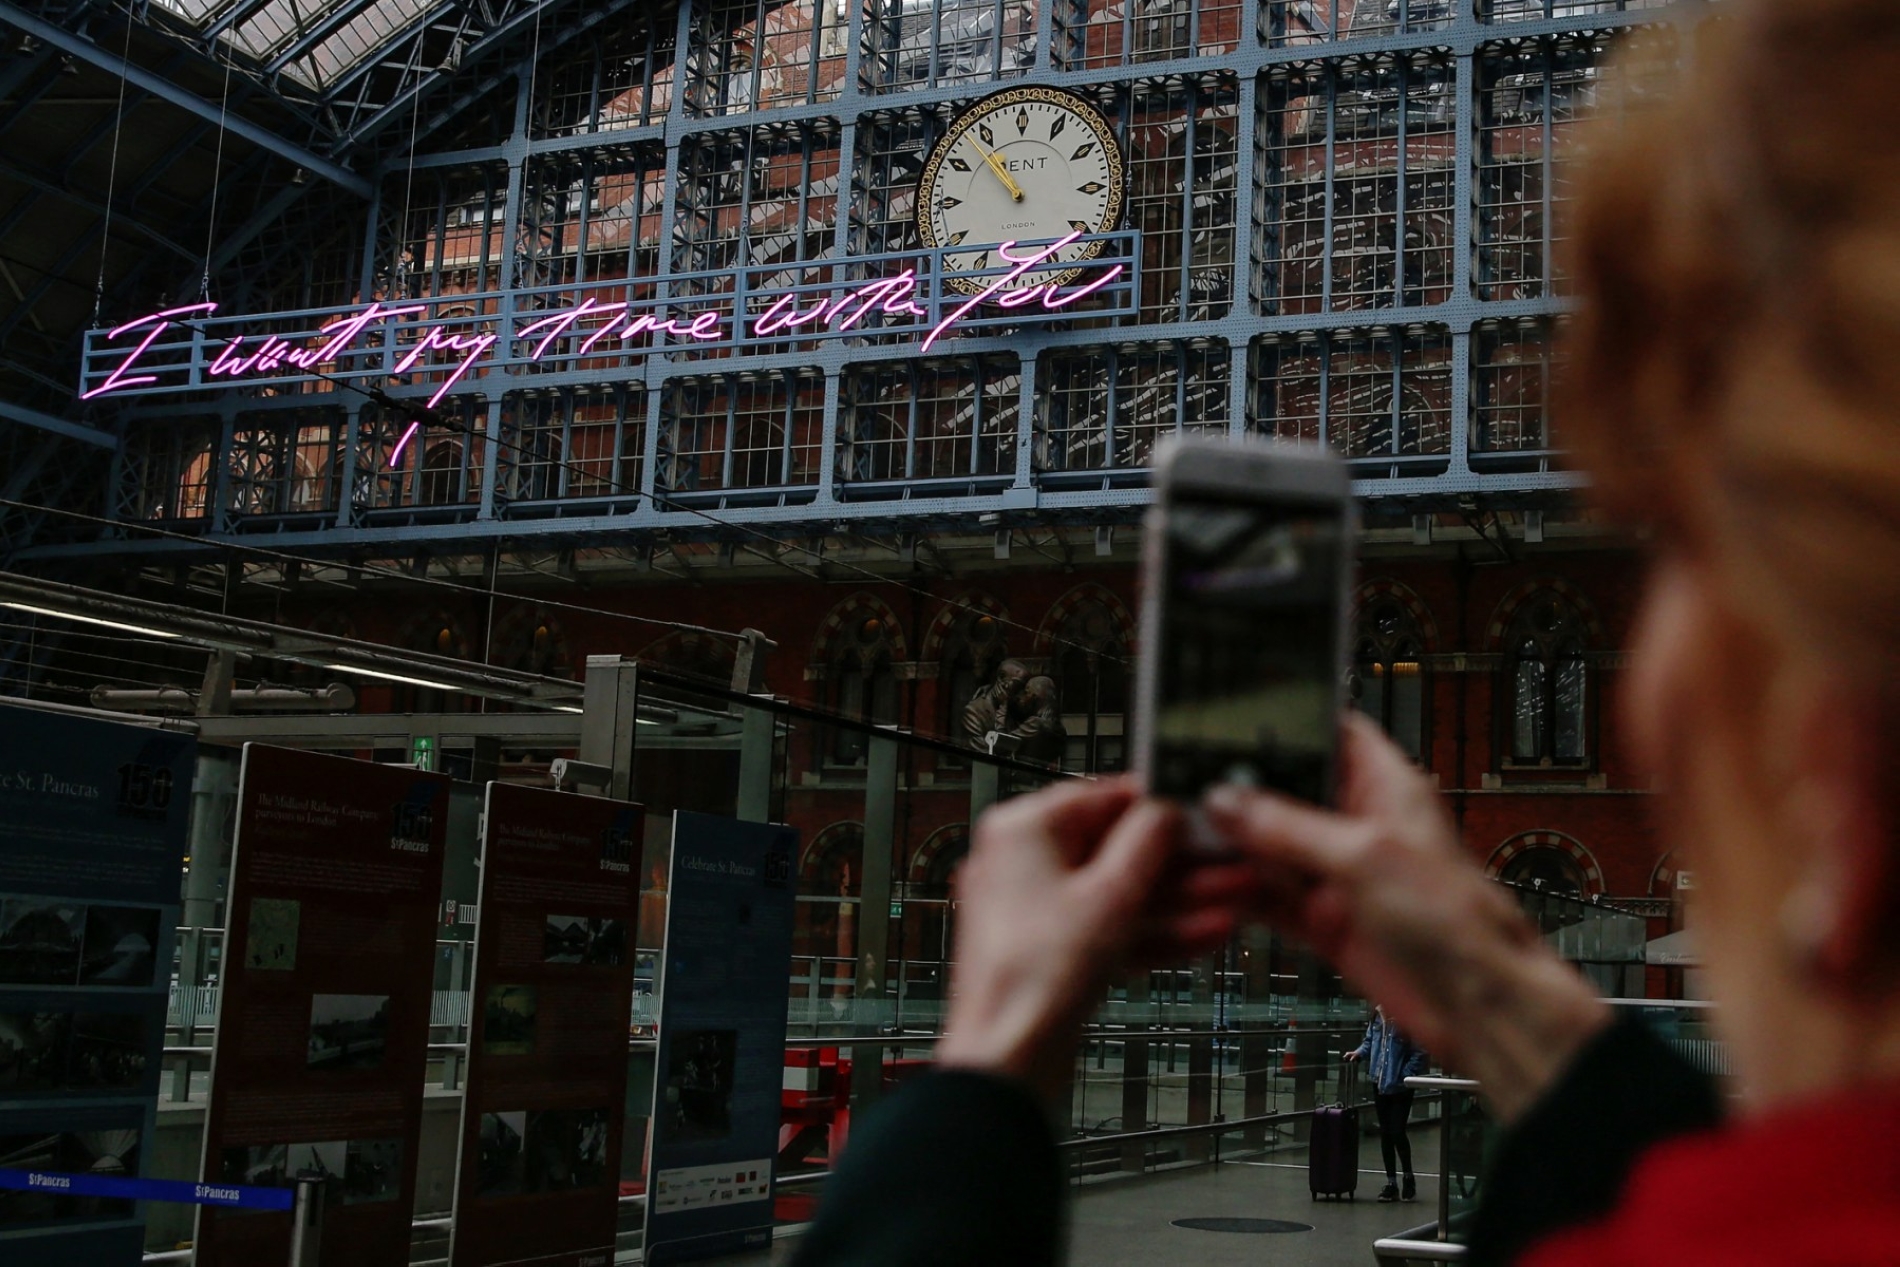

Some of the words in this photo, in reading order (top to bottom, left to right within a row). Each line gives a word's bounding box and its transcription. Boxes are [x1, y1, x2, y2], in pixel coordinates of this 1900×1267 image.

[1001, 221, 1035, 230] LONDON
[80, 301, 218, 399] I
[209, 301, 427, 376] want
[388, 324, 498, 468] my
[754, 268, 925, 336] with
[920, 230, 1124, 352] You
[16, 769, 36, 792] St.
[42, 772, 100, 799] Pancras
[117, 761, 174, 809] 150
